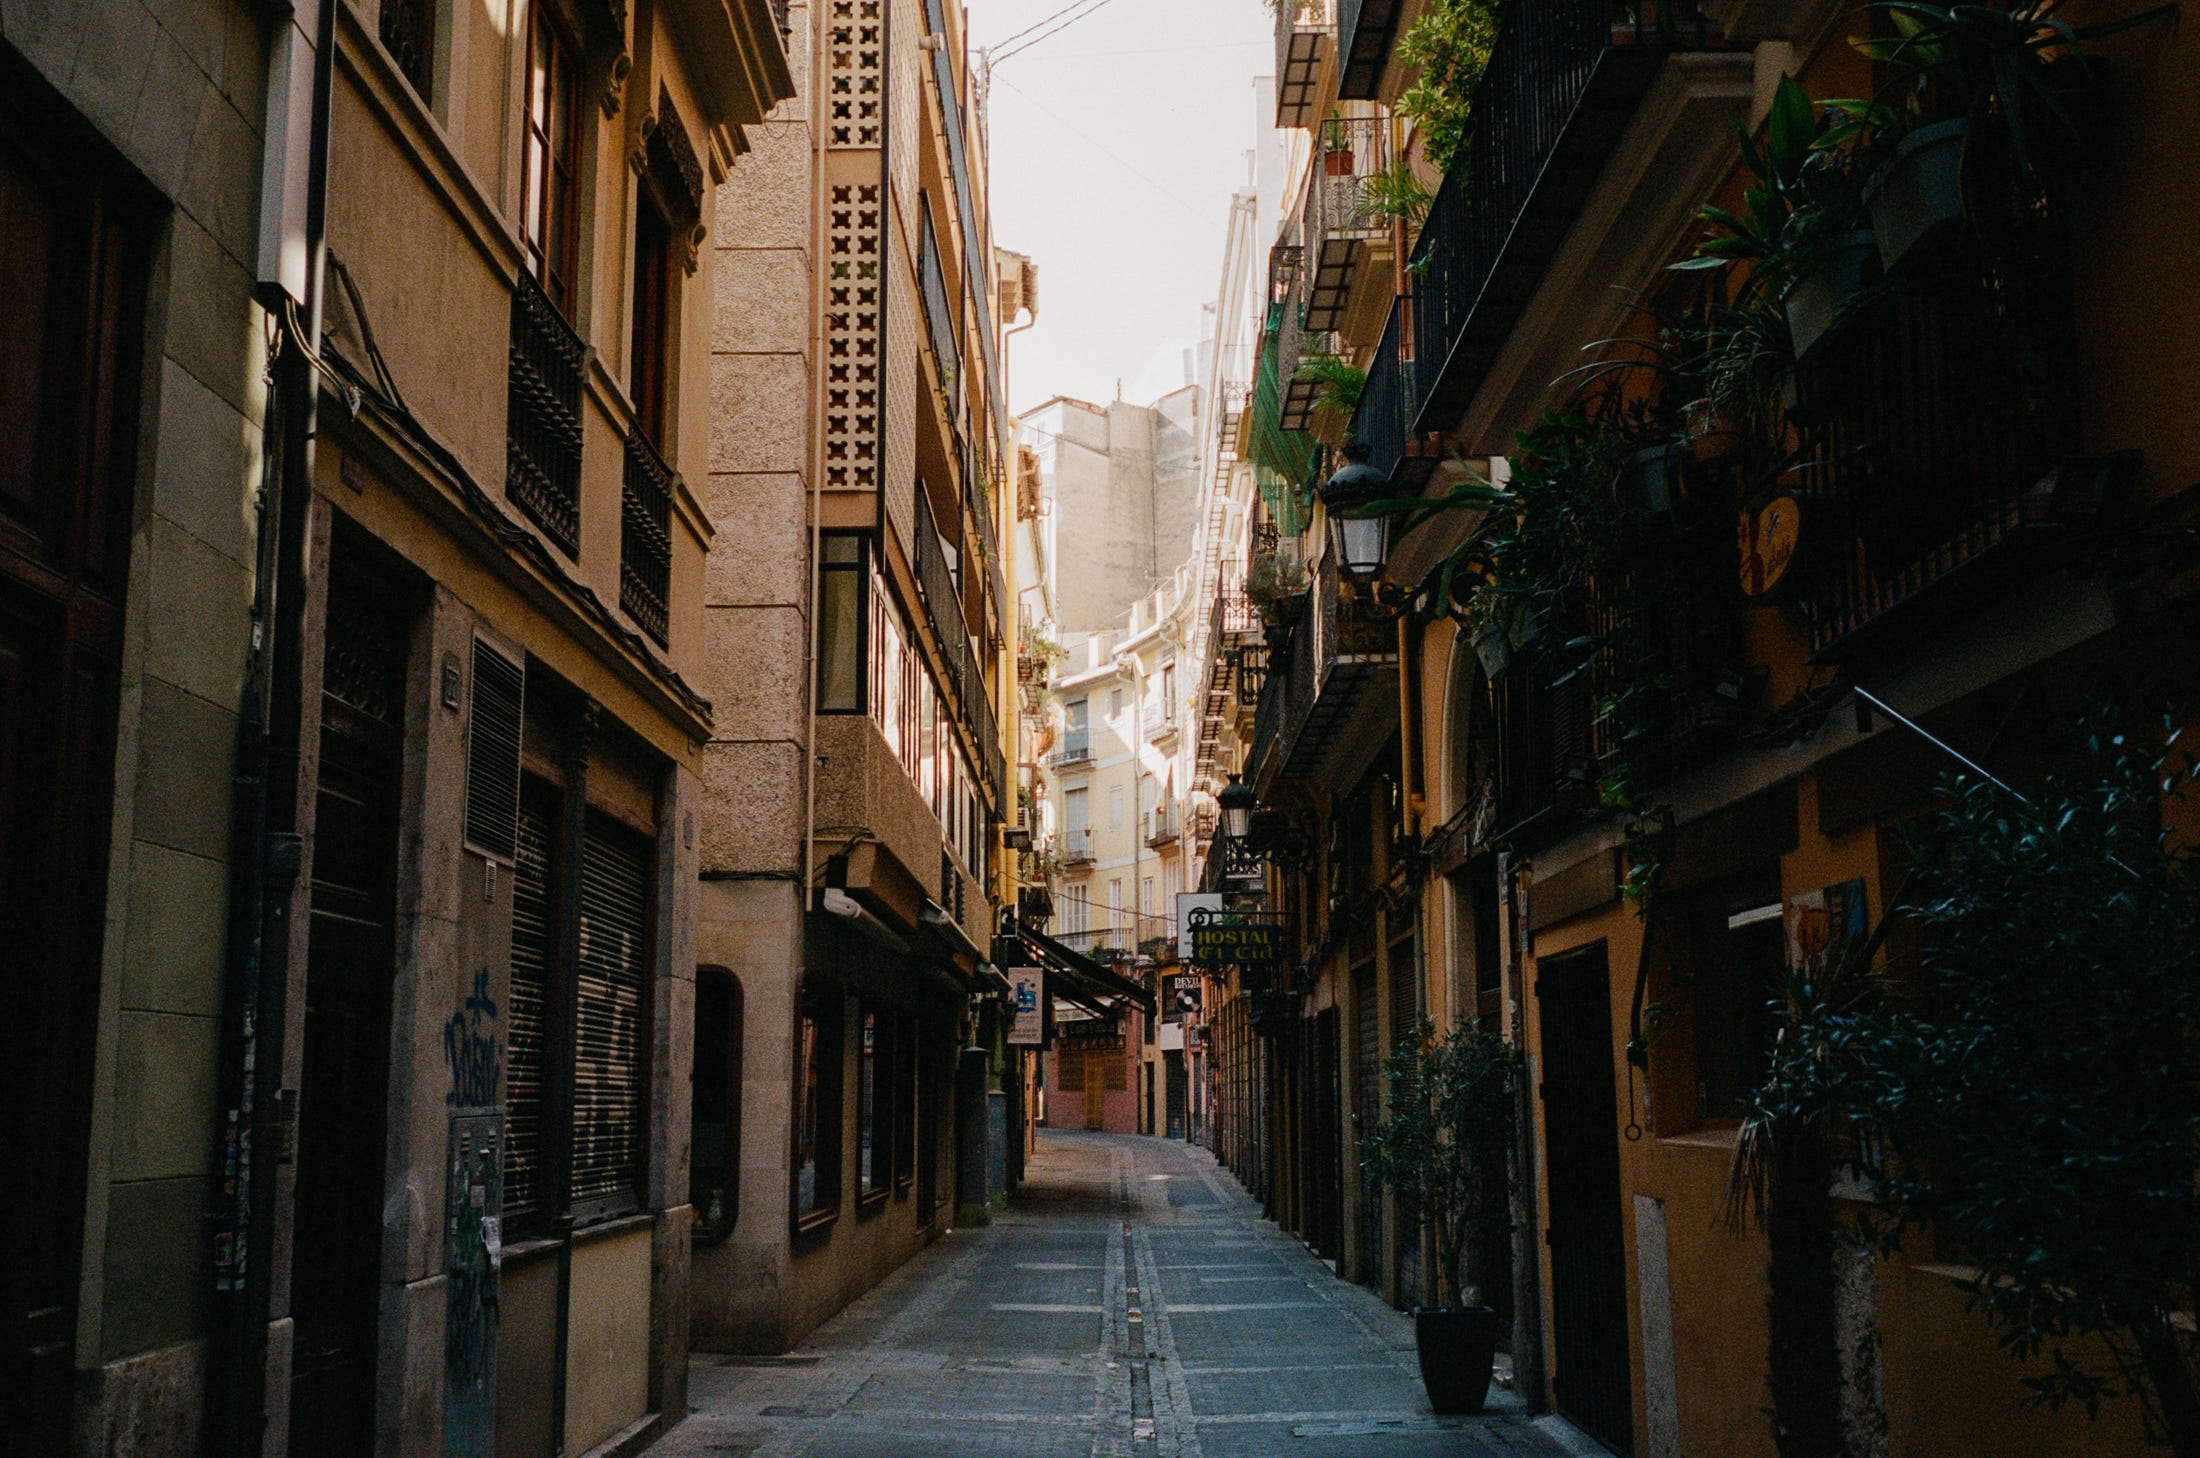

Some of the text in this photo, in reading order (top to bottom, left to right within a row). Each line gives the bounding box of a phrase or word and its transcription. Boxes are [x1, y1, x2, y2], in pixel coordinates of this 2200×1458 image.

[1197, 930, 1271, 945] HOSTAL
[1234, 945, 1274, 960] Cid
[1174, 976, 1201, 985] DEVIL
